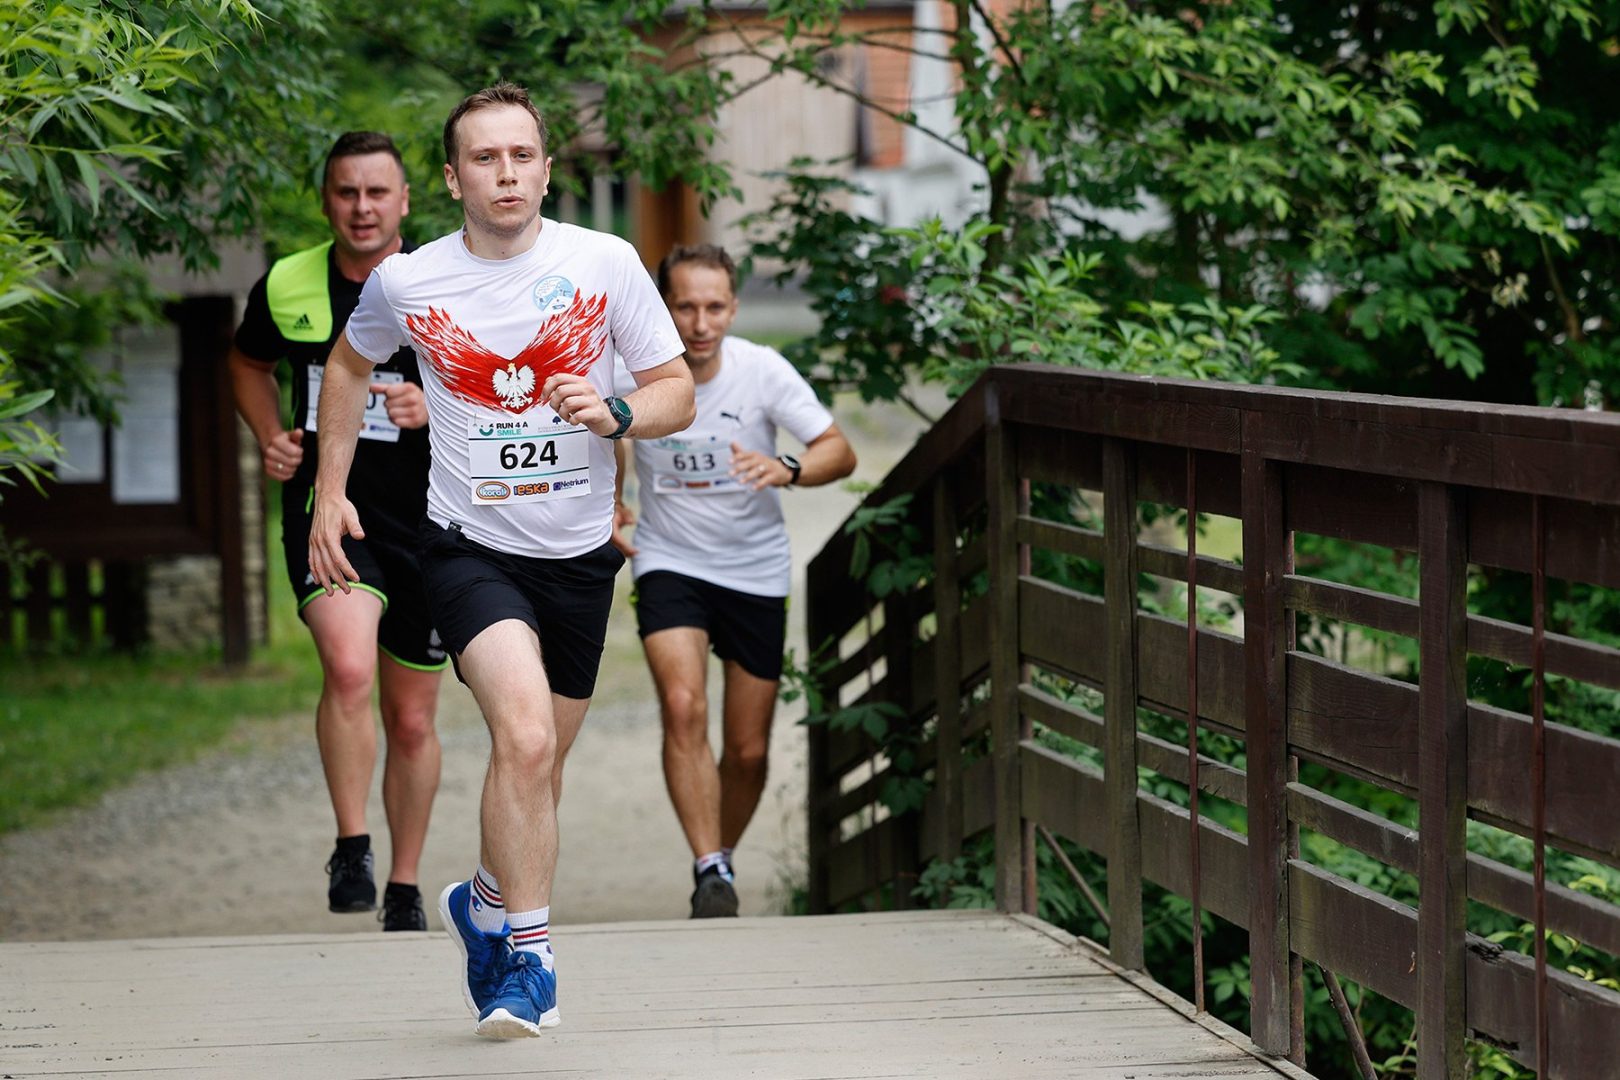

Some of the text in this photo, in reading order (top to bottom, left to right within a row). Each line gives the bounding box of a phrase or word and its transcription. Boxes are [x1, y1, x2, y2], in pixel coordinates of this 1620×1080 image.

[497, 428, 522, 436] SMILE
[500, 440, 558, 470] 624
[673, 453, 715, 472] 613
[560, 478, 589, 488] Netrium
